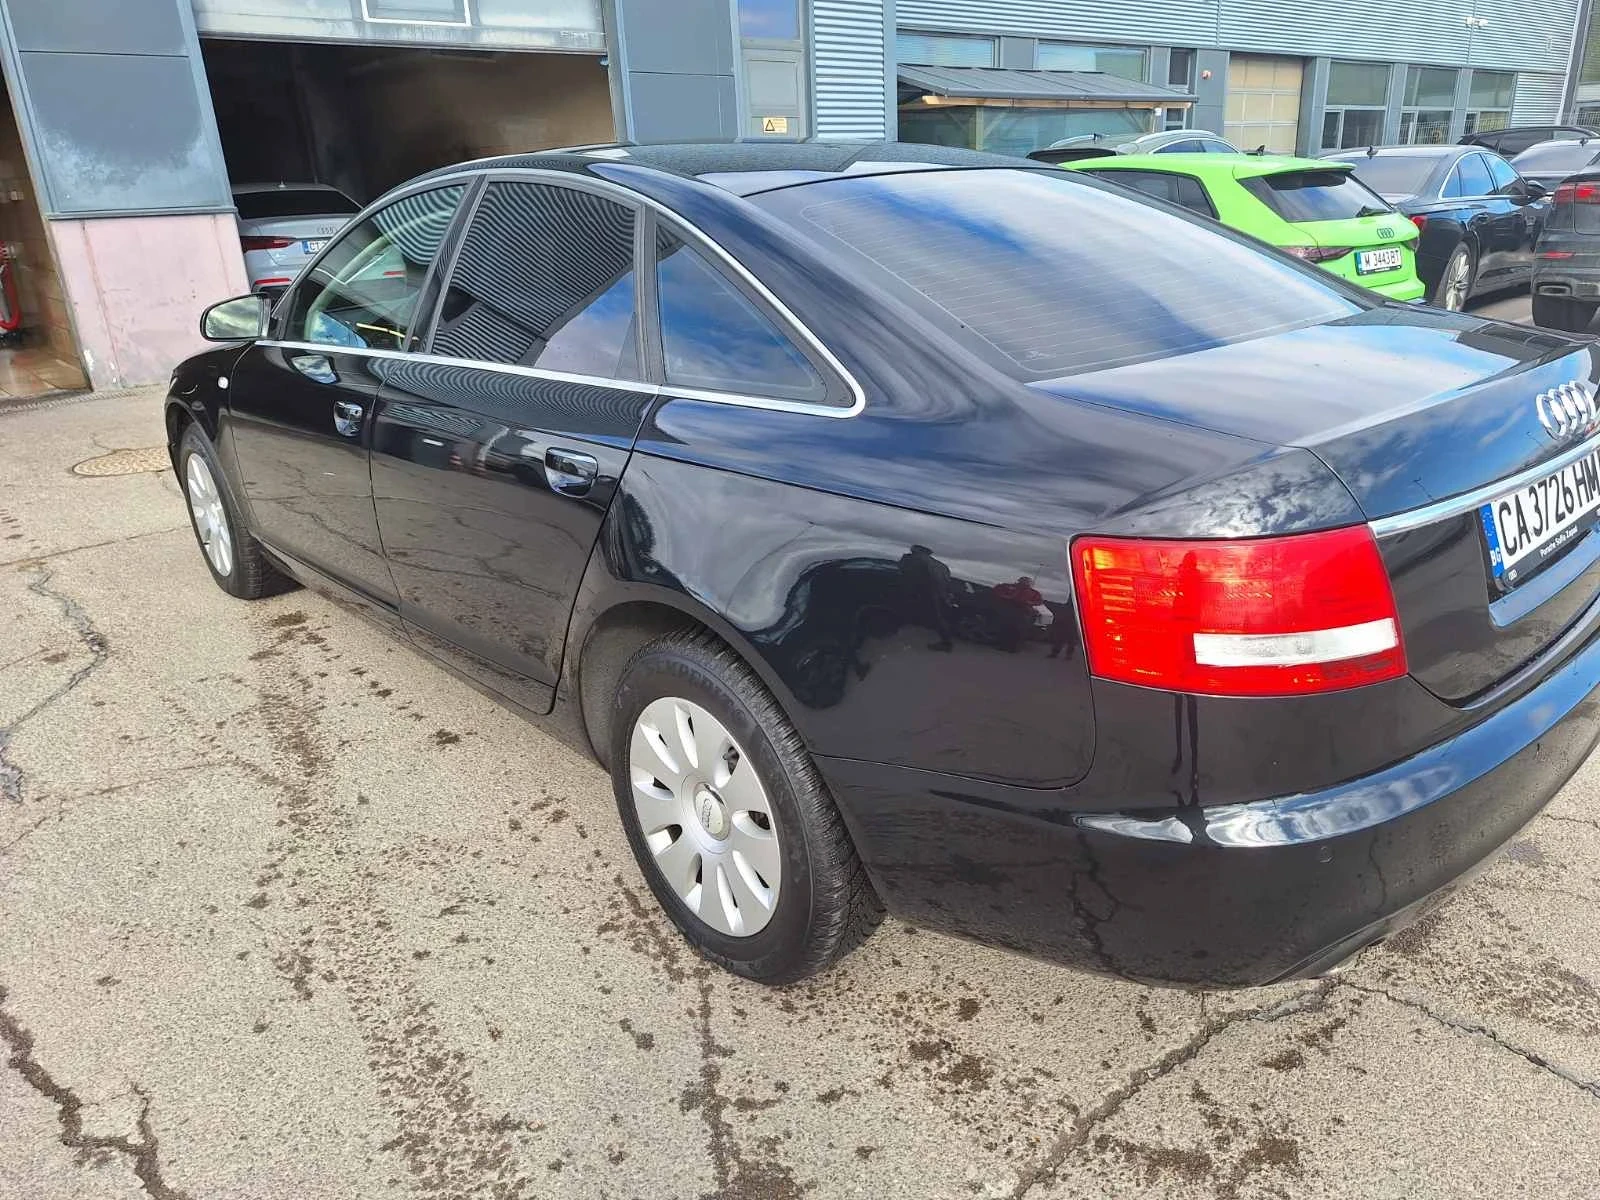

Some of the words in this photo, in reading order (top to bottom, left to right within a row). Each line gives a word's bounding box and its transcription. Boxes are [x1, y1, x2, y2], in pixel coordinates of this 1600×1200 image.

[1499, 494, 1531, 556] CA
[1529, 470, 1574, 537] 3726
[1573, 452, 1600, 508] HM
[1490, 547, 1502, 566] BG
